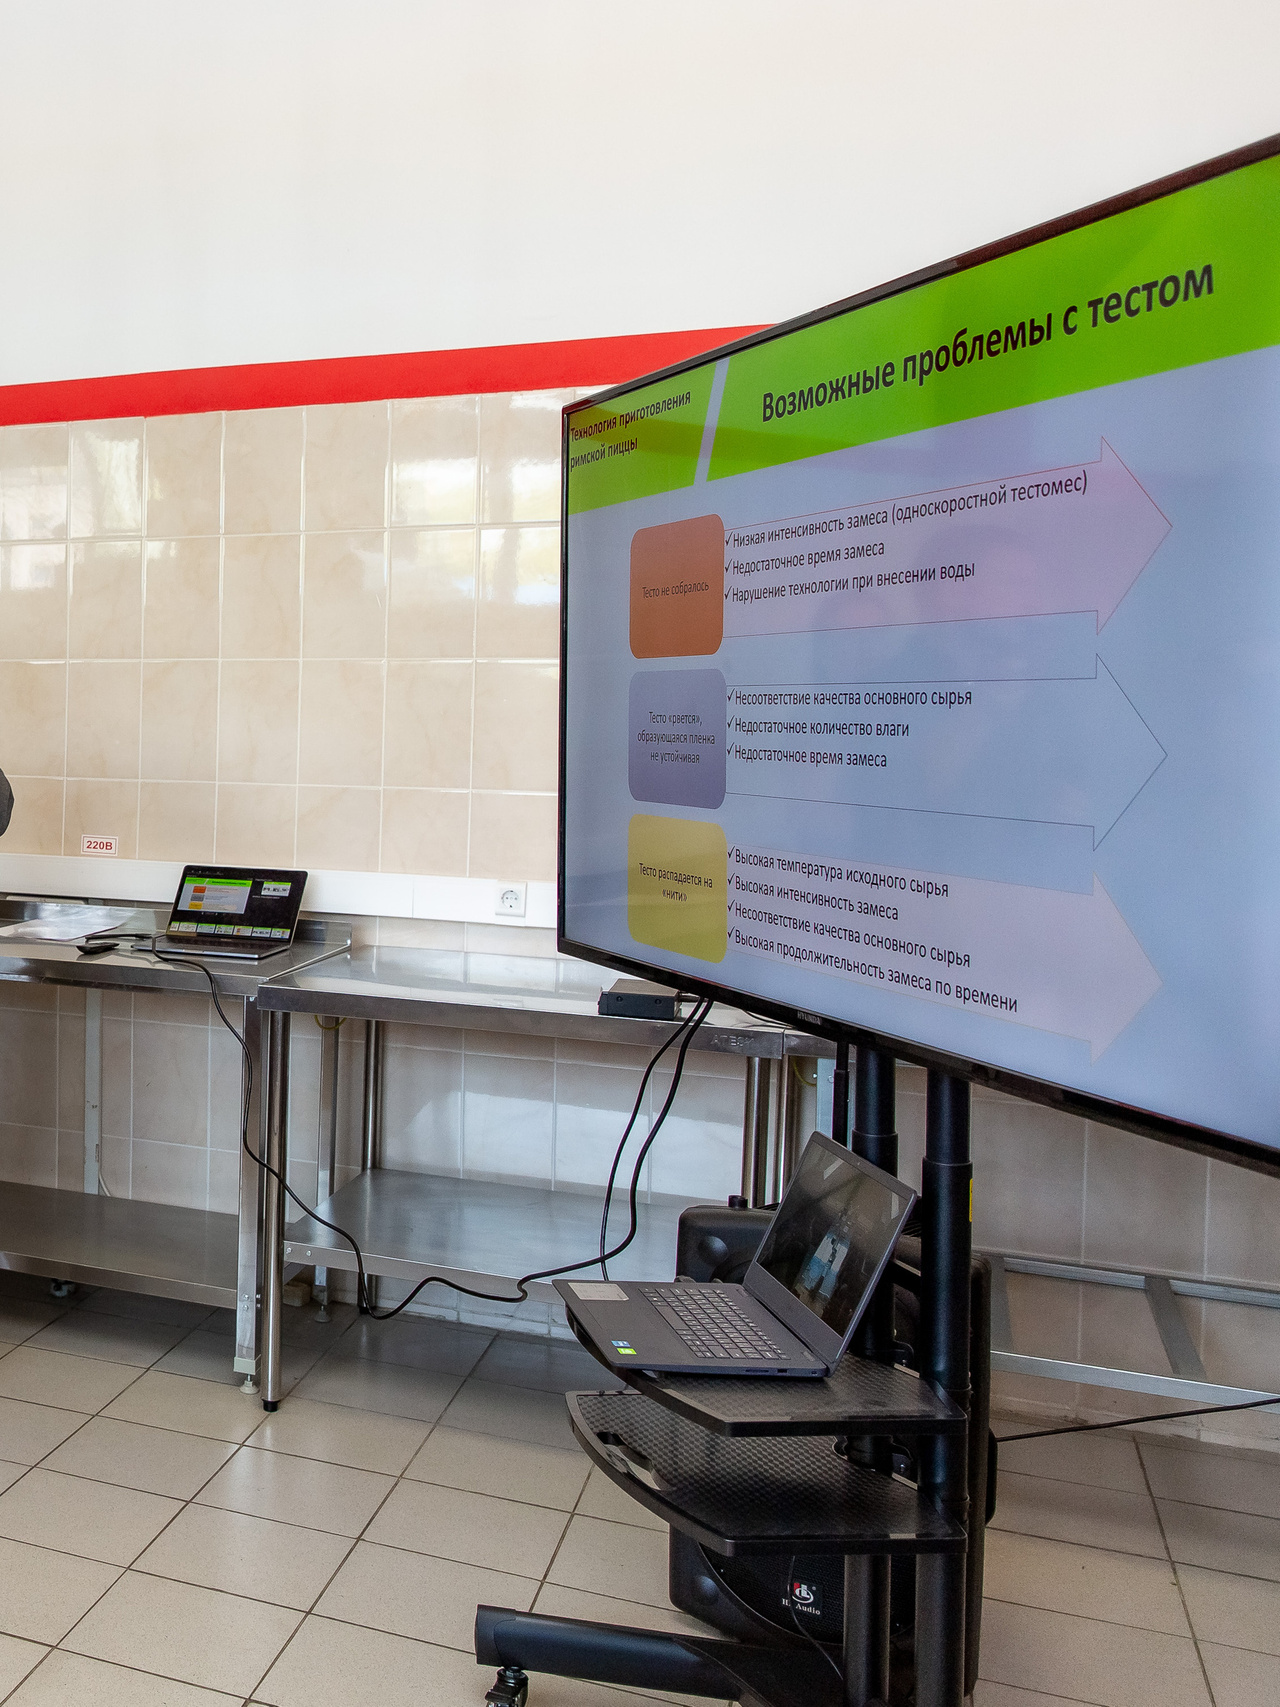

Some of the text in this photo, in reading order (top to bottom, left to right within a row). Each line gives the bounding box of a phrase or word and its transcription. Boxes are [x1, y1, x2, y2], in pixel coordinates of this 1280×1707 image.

[762, 263, 1214, 423] Возможные проблемы с тестом
[570, 391, 691, 443] Технология приготовления
[570, 437, 638, 472] римской пиццы
[733, 469, 1088, 549] Низкая интенсивность замеса (односкоростной тестомес)
[732, 541, 885, 578] Недостаточное время замеса
[642, 580, 710, 599] Тесто не собралось
[732, 562, 975, 605] Нарушение технологии при внесении воды
[734, 689, 972, 709] Несоответствие качества основного сырья
[649, 711, 667, 724] Тесто
[734, 717, 910, 737] Недостаточное количество влаги
[637, 729, 716, 746] образующаяся пленка
[650, 749, 700, 765] не устойчивая
[734, 745, 887, 768] Недостаточное время замеса
[639, 862, 713, 889] Тесто распадается на
[735, 848, 949, 899] Высокая температура исходного сырья
[735, 875, 899, 921] Высокая интенсивность замеса
[735, 902, 971, 968] Несоответствие качества основного сырья
[735, 929, 1018, 1014] Высокая продолжительность замеса по времени
[795, 1603, 821, 1615] Audio
